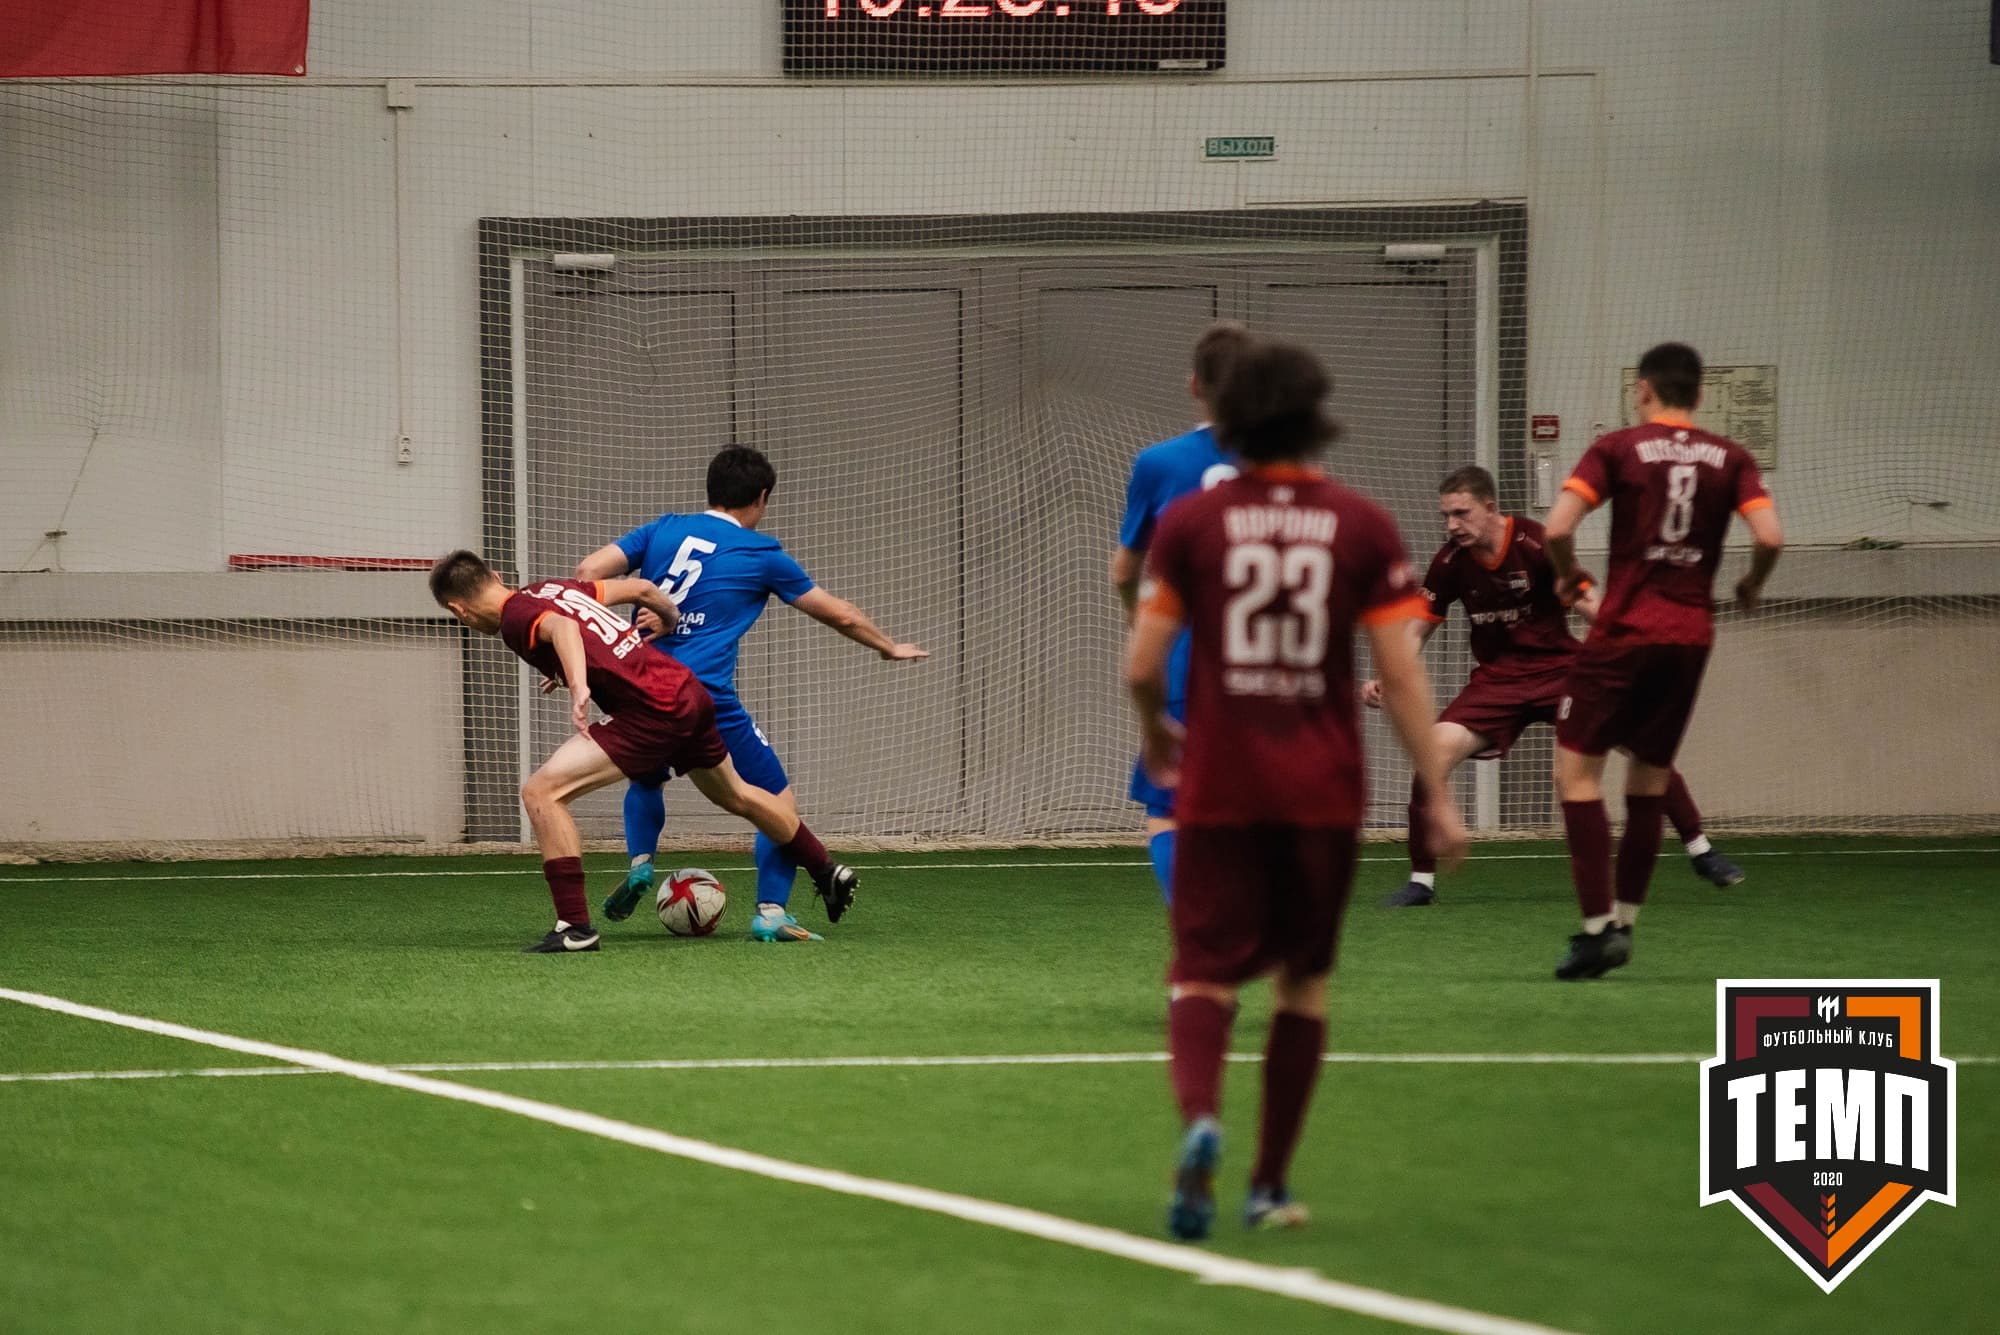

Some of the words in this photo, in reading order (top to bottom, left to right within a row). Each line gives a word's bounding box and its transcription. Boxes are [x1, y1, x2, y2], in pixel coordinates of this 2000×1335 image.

[1208, 140, 1272, 155] ВЫХОД
[1661, 465, 1698, 543] 8
[658, 535, 717, 606] 5
[1224, 543, 1335, 669] 23
[553, 588, 632, 646] 30
